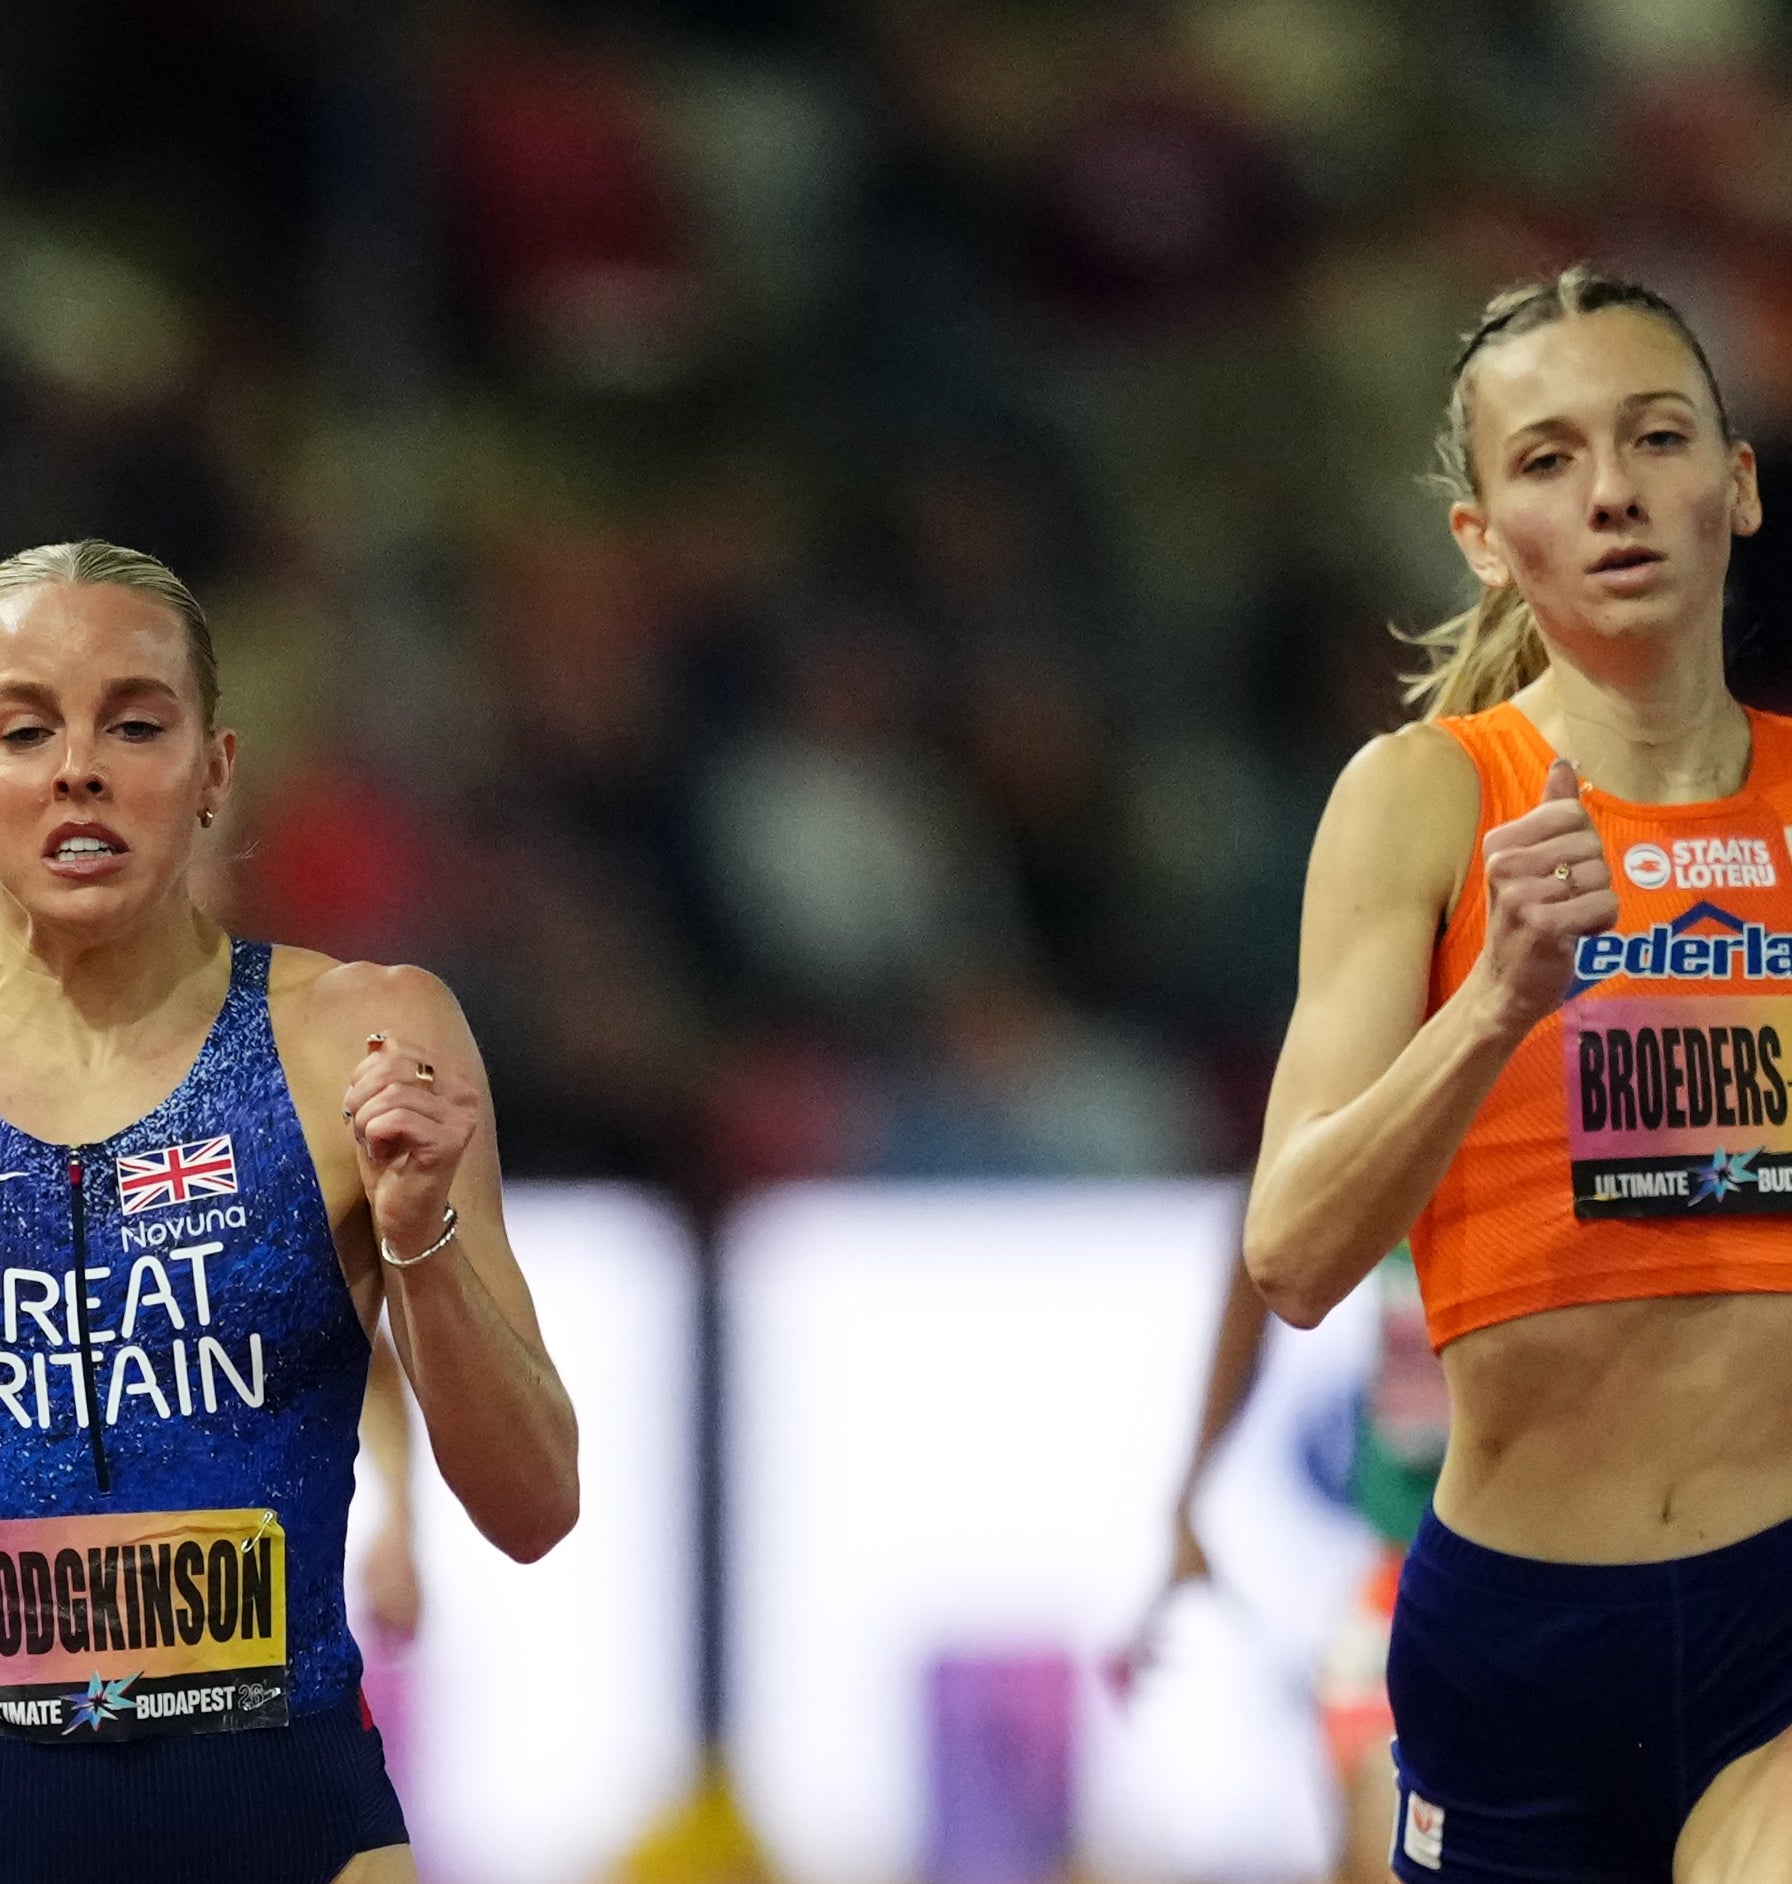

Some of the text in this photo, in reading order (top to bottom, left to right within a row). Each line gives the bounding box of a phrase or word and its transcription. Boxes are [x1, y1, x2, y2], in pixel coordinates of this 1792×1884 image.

[1672, 838, 1770, 866] STAATS
[1595, 1171, 1690, 1199] ULTIMATE
[121, 1206, 246, 1253] Novuna
[136, 1686, 236, 1720] BUDAPEST
